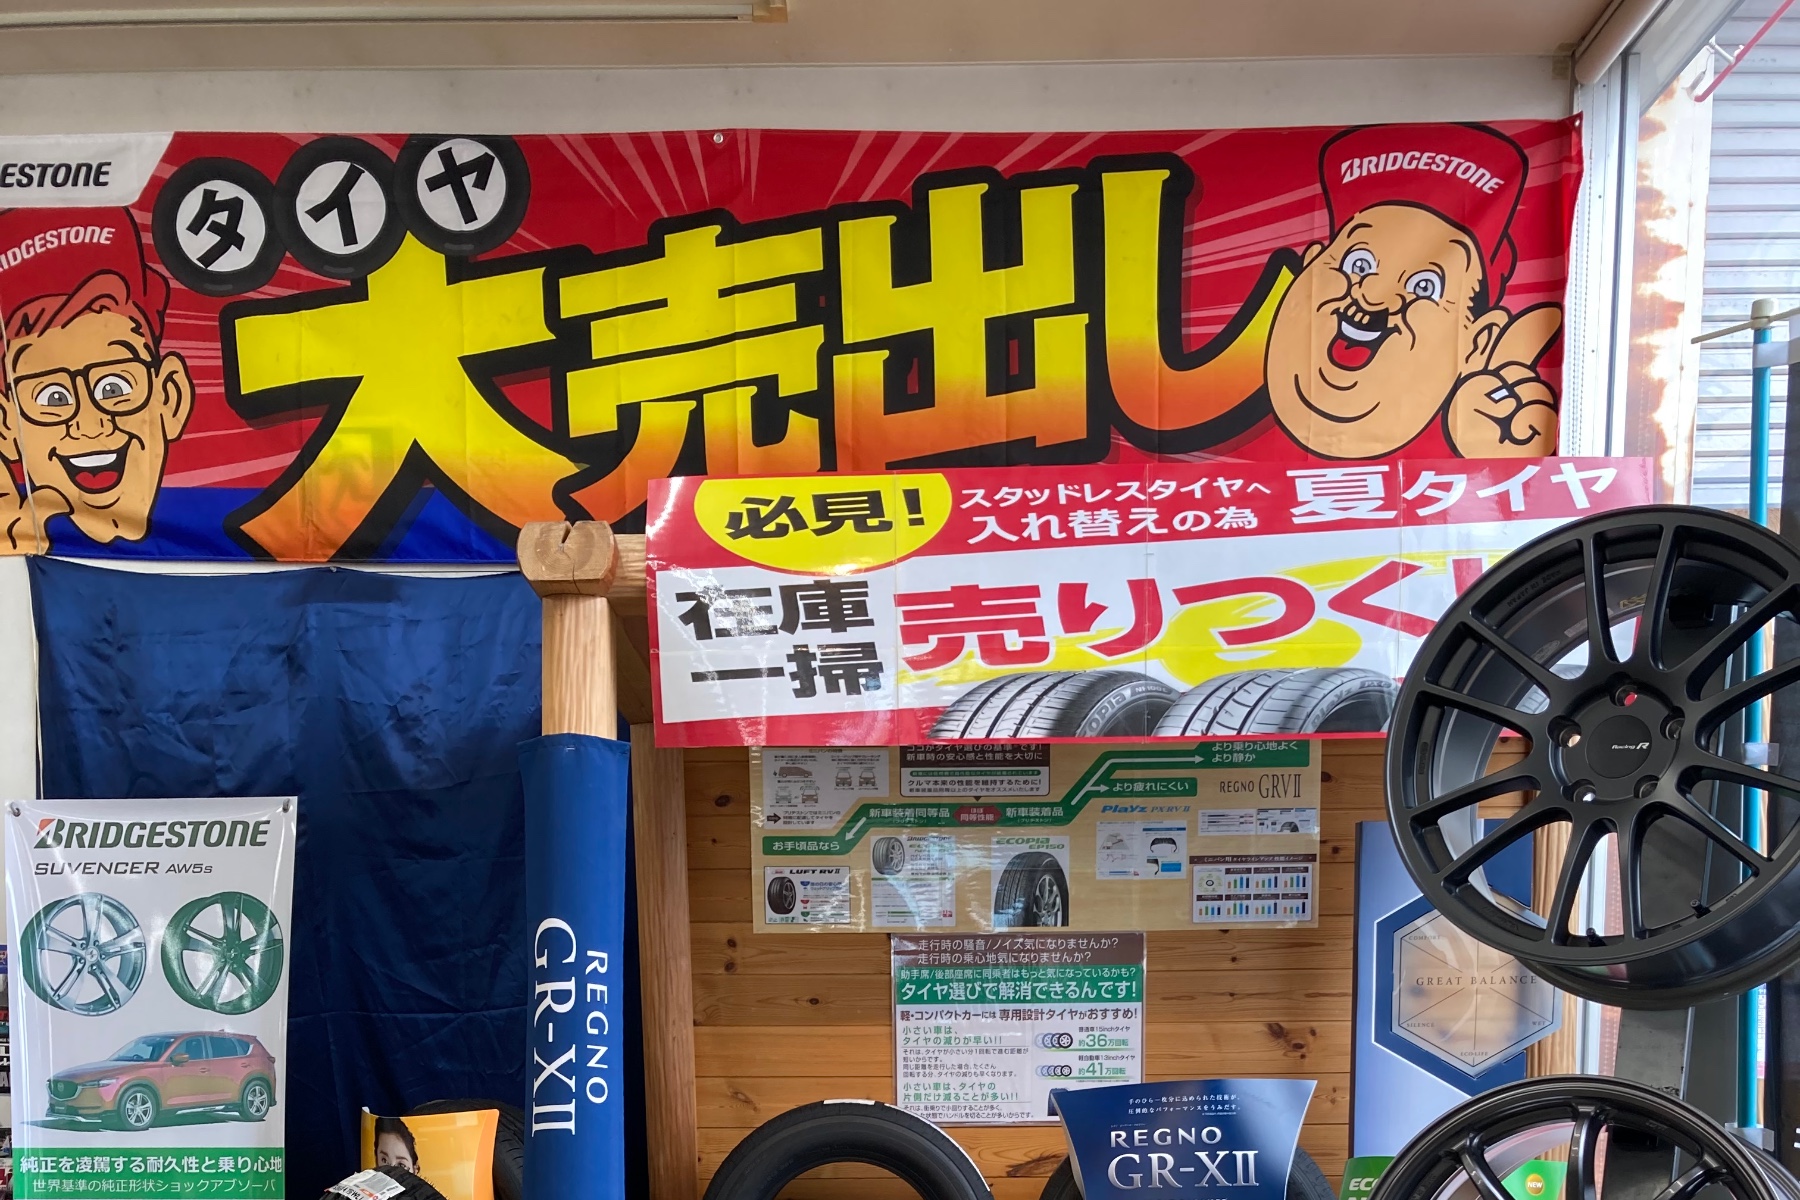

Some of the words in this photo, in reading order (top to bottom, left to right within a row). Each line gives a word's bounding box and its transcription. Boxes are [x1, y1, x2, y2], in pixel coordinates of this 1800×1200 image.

[1340, 150, 1504, 195] BRIDGESTONE
[188, 147, 496, 269] タイヤ
[0, 226, 116, 272] IDGESTONE
[235, 169, 1295, 562] 大売出し
[960, 477, 1271, 510] スタッドレスタイヤへ
[1287, 461, 1618, 524] 夏タイヤ
[724, 488, 925, 541] 必見!
[967, 505, 1259, 545] 入れ替えの為
[673, 577, 874, 641] 在庫
[690, 640, 884, 698] 一掃
[1211, 752, 1256, 763] より静か
[1112, 781, 1189, 793] より疲れにくい
[1219, 780, 1255, 794] REGNO
[869, 808, 950, 819] 新車装着同等品
[960, 813, 995, 822] 同等性能
[1005, 807, 1064, 817] 新車装着品
[34, 819, 271, 849] BRIDGESTONE
[772, 841, 840, 851] お手頃品なら
[34, 861, 160, 875] SUVENCER
[918, 938, 1119, 951] 走行時の騒音/ノイズ気になりませんか?
[917, 952, 1092, 965] 走行時の乗心地気になりませんか?
[1416, 976, 1463, 986] GREAT
[1470, 975, 1538, 985] BALANCE
[901, 982, 1137, 1000] タイヤ選びで解消できるんです!
[585, 950, 609, 1104] REGNO
[1078, 1034, 1129, 1048] 約36万回転
[1078, 1062, 1127, 1076] 約41万回転
[903, 1082, 996, 1091] 小さい車は、タイヤの
[1110, 1126, 1222, 1149] REGNO
[20, 1156, 283, 1174] 純正を凌駕する耐久性と乗り心地
[32, 1177, 276, 1194] 世界基準の純正形状ショックアブソーバ
[1527, 1181, 1544, 1189] NEW
